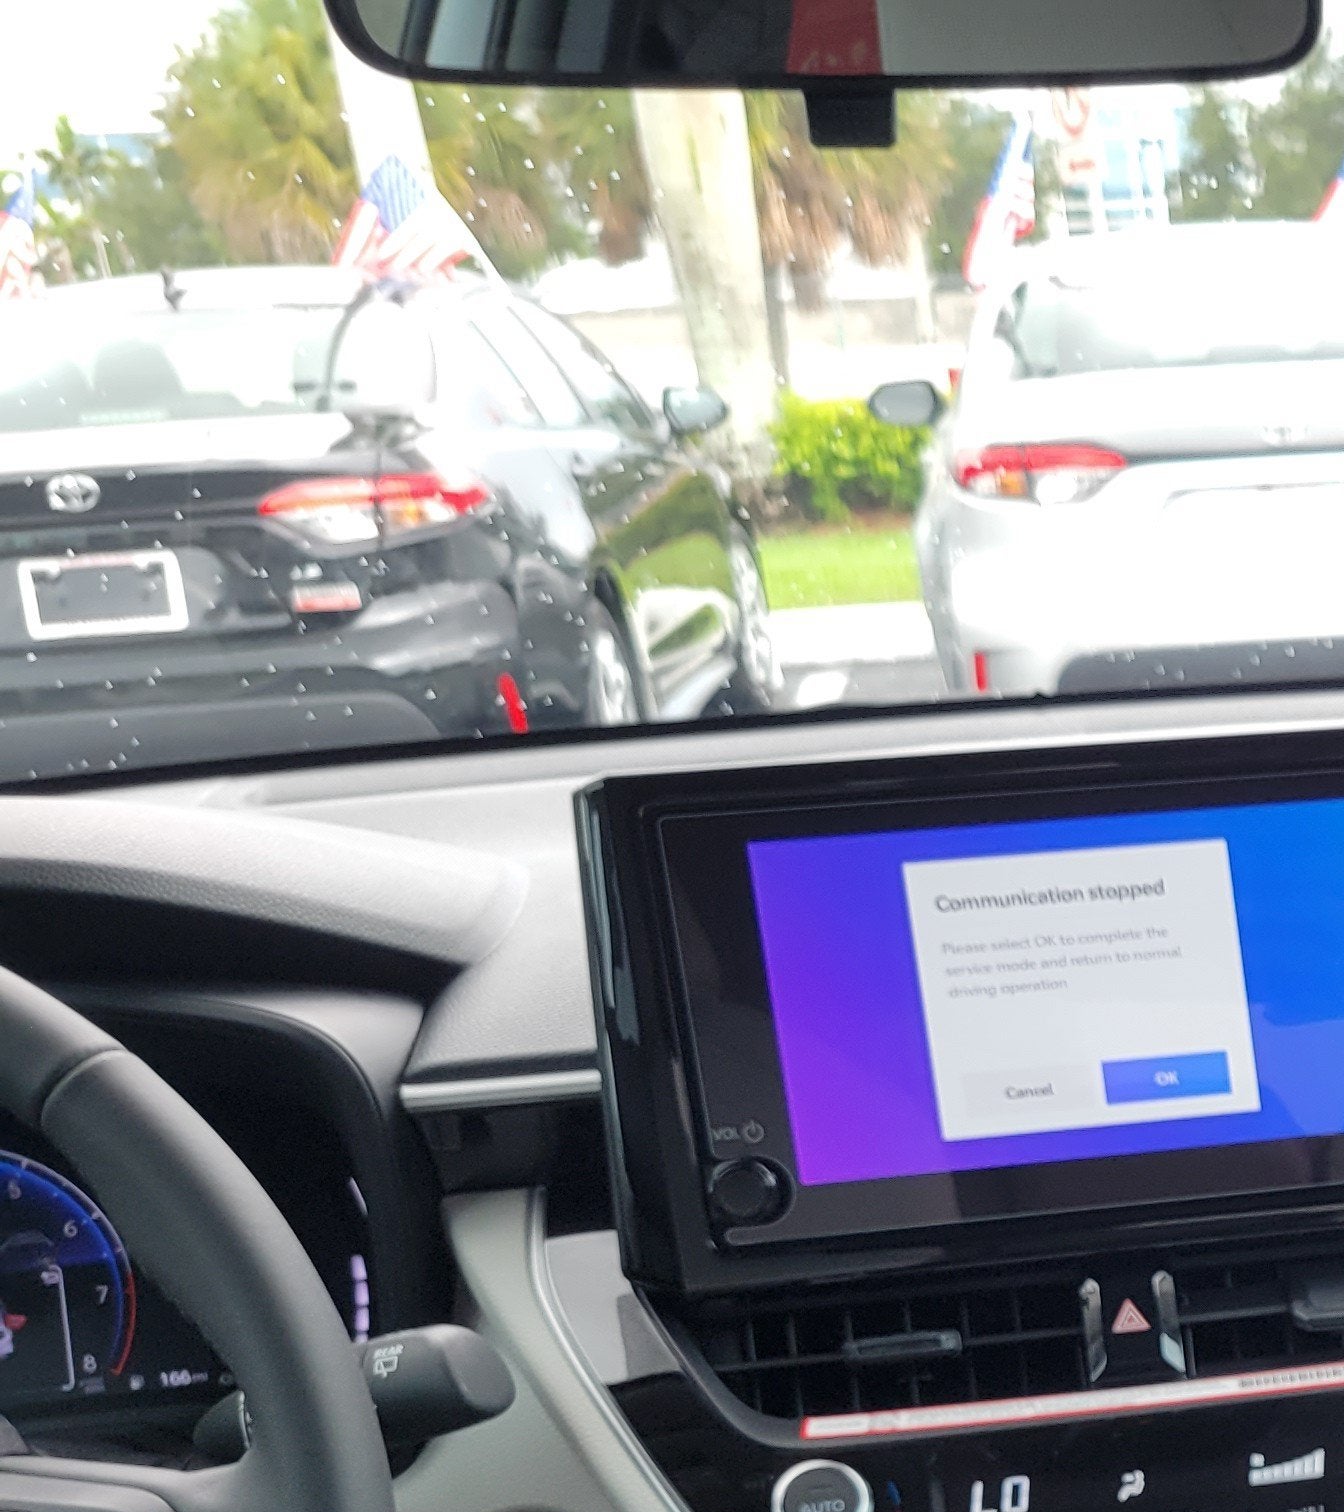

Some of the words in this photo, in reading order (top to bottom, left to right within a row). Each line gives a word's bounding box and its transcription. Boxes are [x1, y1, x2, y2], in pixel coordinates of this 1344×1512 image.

[935, 886, 1085, 913] Communication
[1088, 878, 1165, 902] stopped
[941, 941, 986, 955] Please
[990, 938, 1031, 952] select
[1033, 935, 1056, 949] OK
[1060, 934, 1075, 946] to
[1077, 928, 1142, 945] complete
[1145, 926, 1168, 939] the
[945, 965, 993, 978] service
[995, 958, 1037, 973] mode
[1040, 956, 1067, 970] and
[1070, 953, 1113, 967] return
[1115, 951, 1131, 963] to
[1133, 945, 1182, 961] normal
[948, 985, 998, 999] driving
[1001, 979, 1068, 996] operation
[1005, 1082, 1055, 1100] Cancel
[1155, 1070, 1180, 1087] OK
[62, 1220, 78, 1238] 6
[95, 1284, 109, 1304] 7
[83, 1353, 97, 1374] 8
